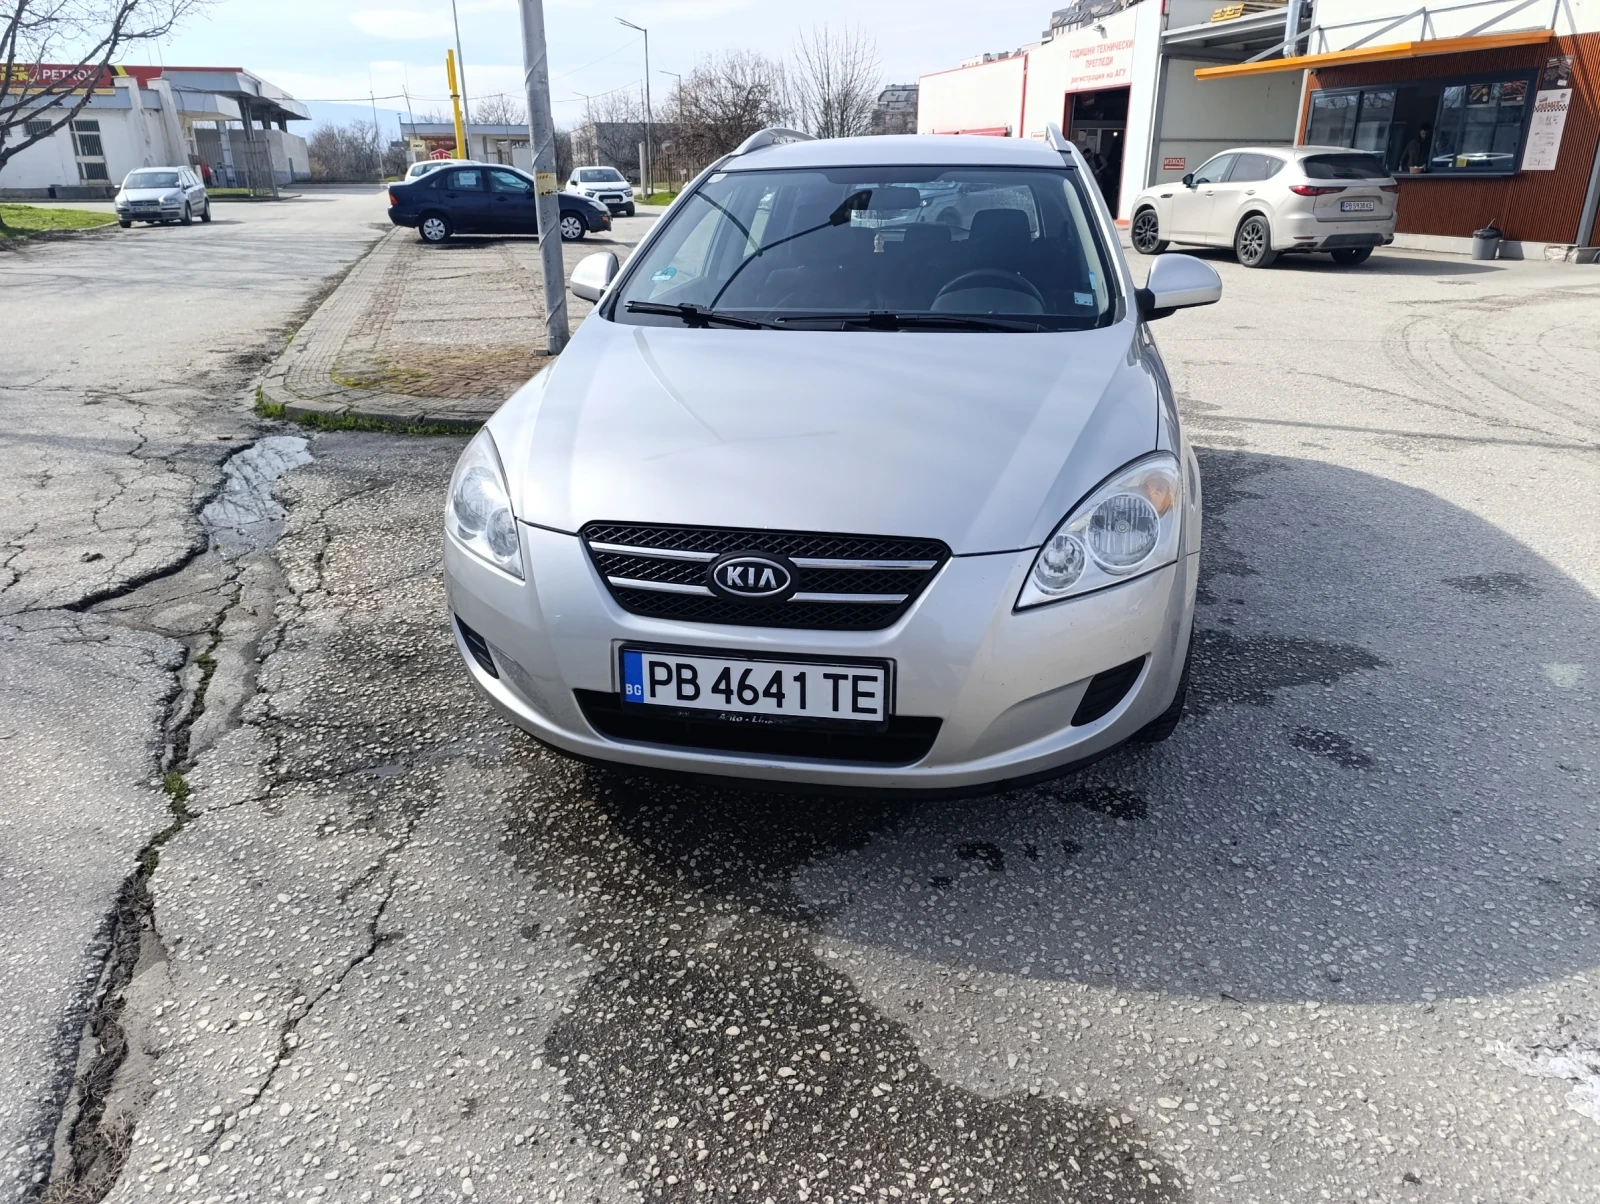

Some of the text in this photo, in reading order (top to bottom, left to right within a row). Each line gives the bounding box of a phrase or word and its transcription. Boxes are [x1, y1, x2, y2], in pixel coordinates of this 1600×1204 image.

[1069, 39, 1134, 59] ГОДИШНИ ТЕХНИЧЕСКИ
[1085, 56, 1113, 69] ПРЕГЛЕДИ
[1071, 68, 1126, 84] регистрация на АГУ
[1164, 158, 1185, 166] ИЗХОД
[727, 566, 777, 588] KIA
[625, 683, 642, 696] BG
[648, 660, 878, 715] PB 4641 TE
